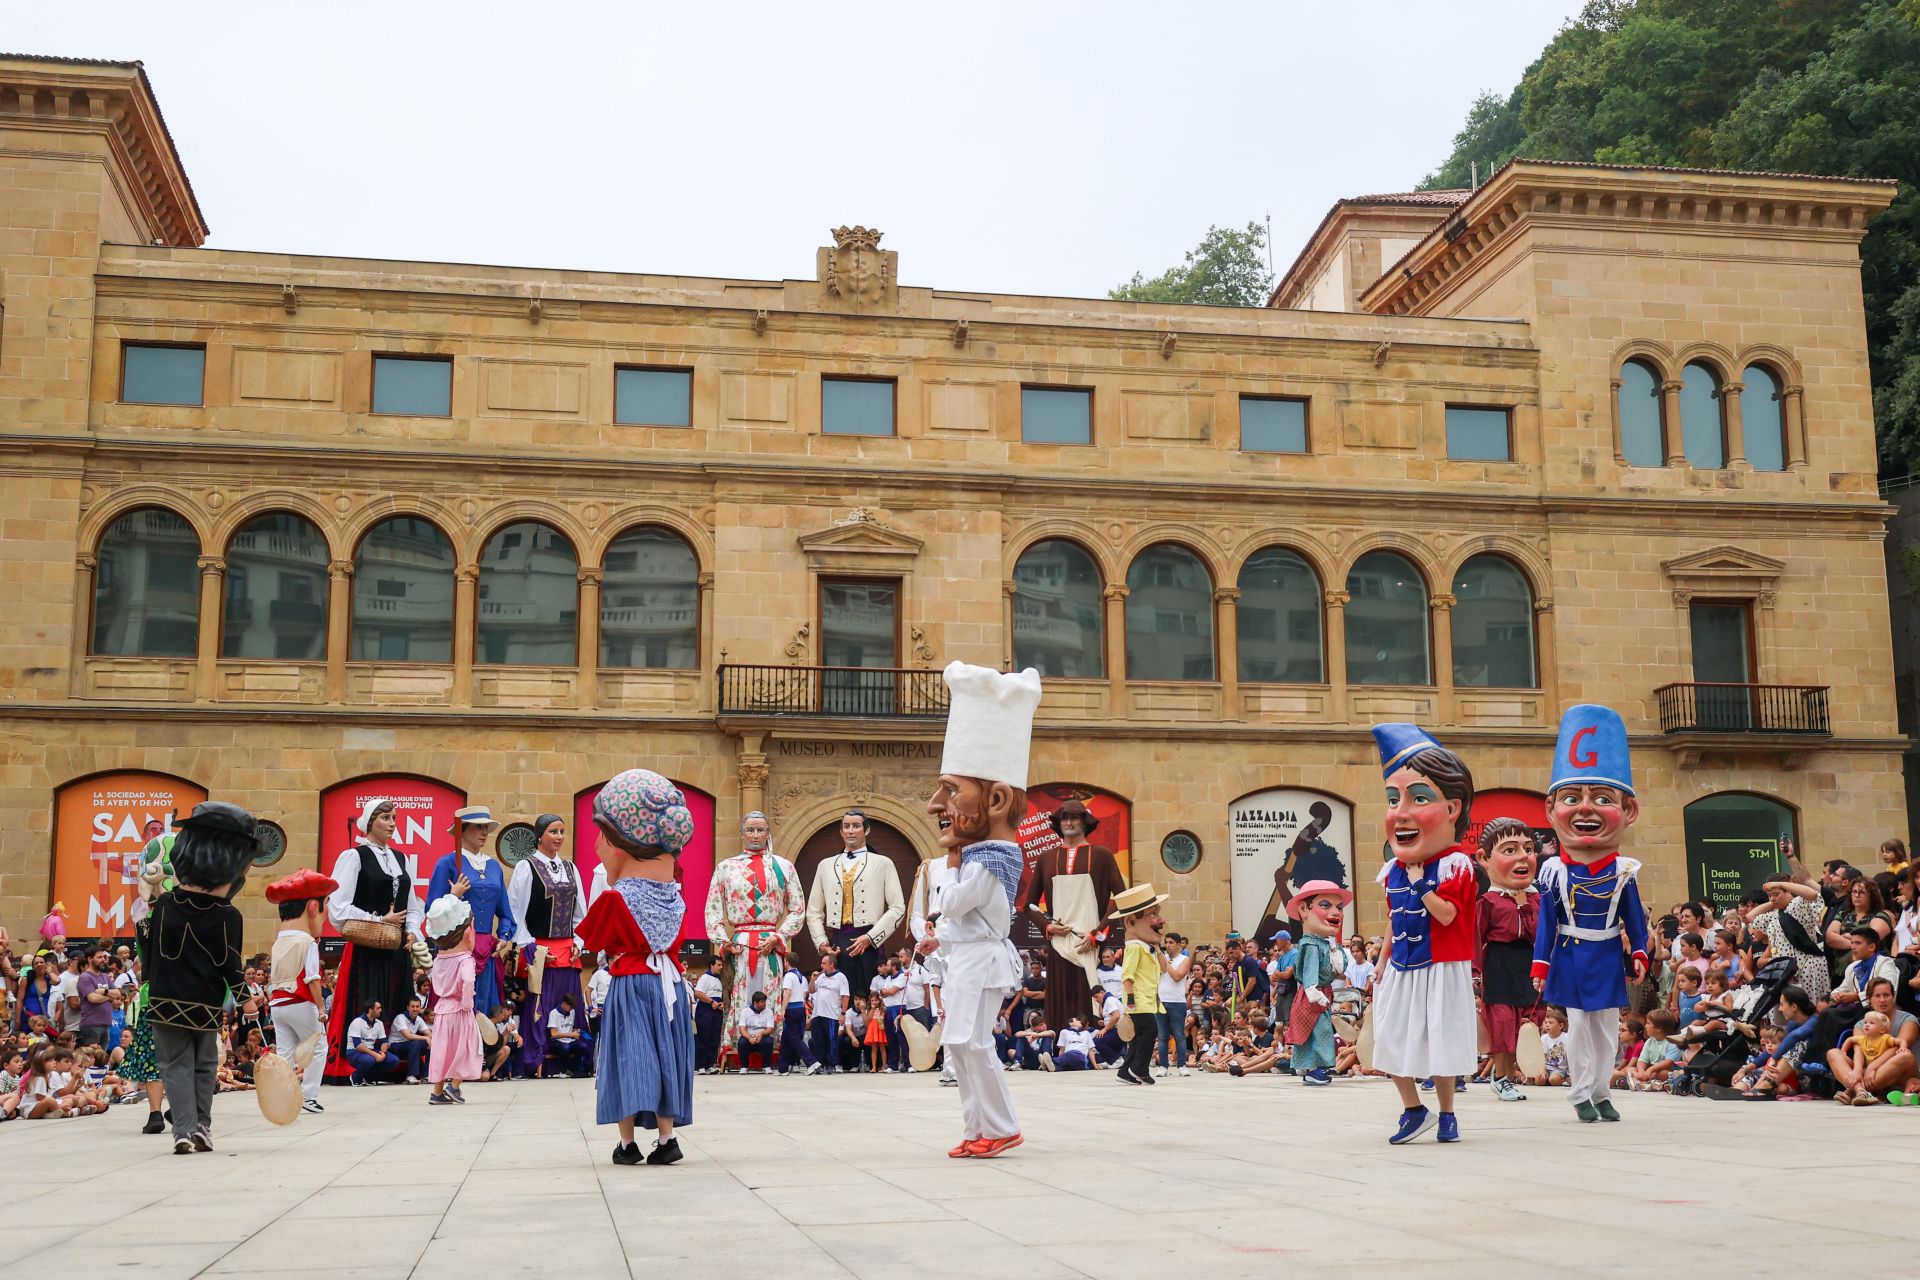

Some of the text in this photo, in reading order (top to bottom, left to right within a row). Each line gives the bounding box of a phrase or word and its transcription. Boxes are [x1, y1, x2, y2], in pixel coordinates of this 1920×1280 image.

[779, 741, 938, 758] MUSEO MUNICIPAL
[1568, 725, 1598, 769] G
[1235, 810, 1297, 821] JAZZALDIA
[1711, 869, 1740, 878] Denda
[1712, 881, 1742, 890] Tienda
